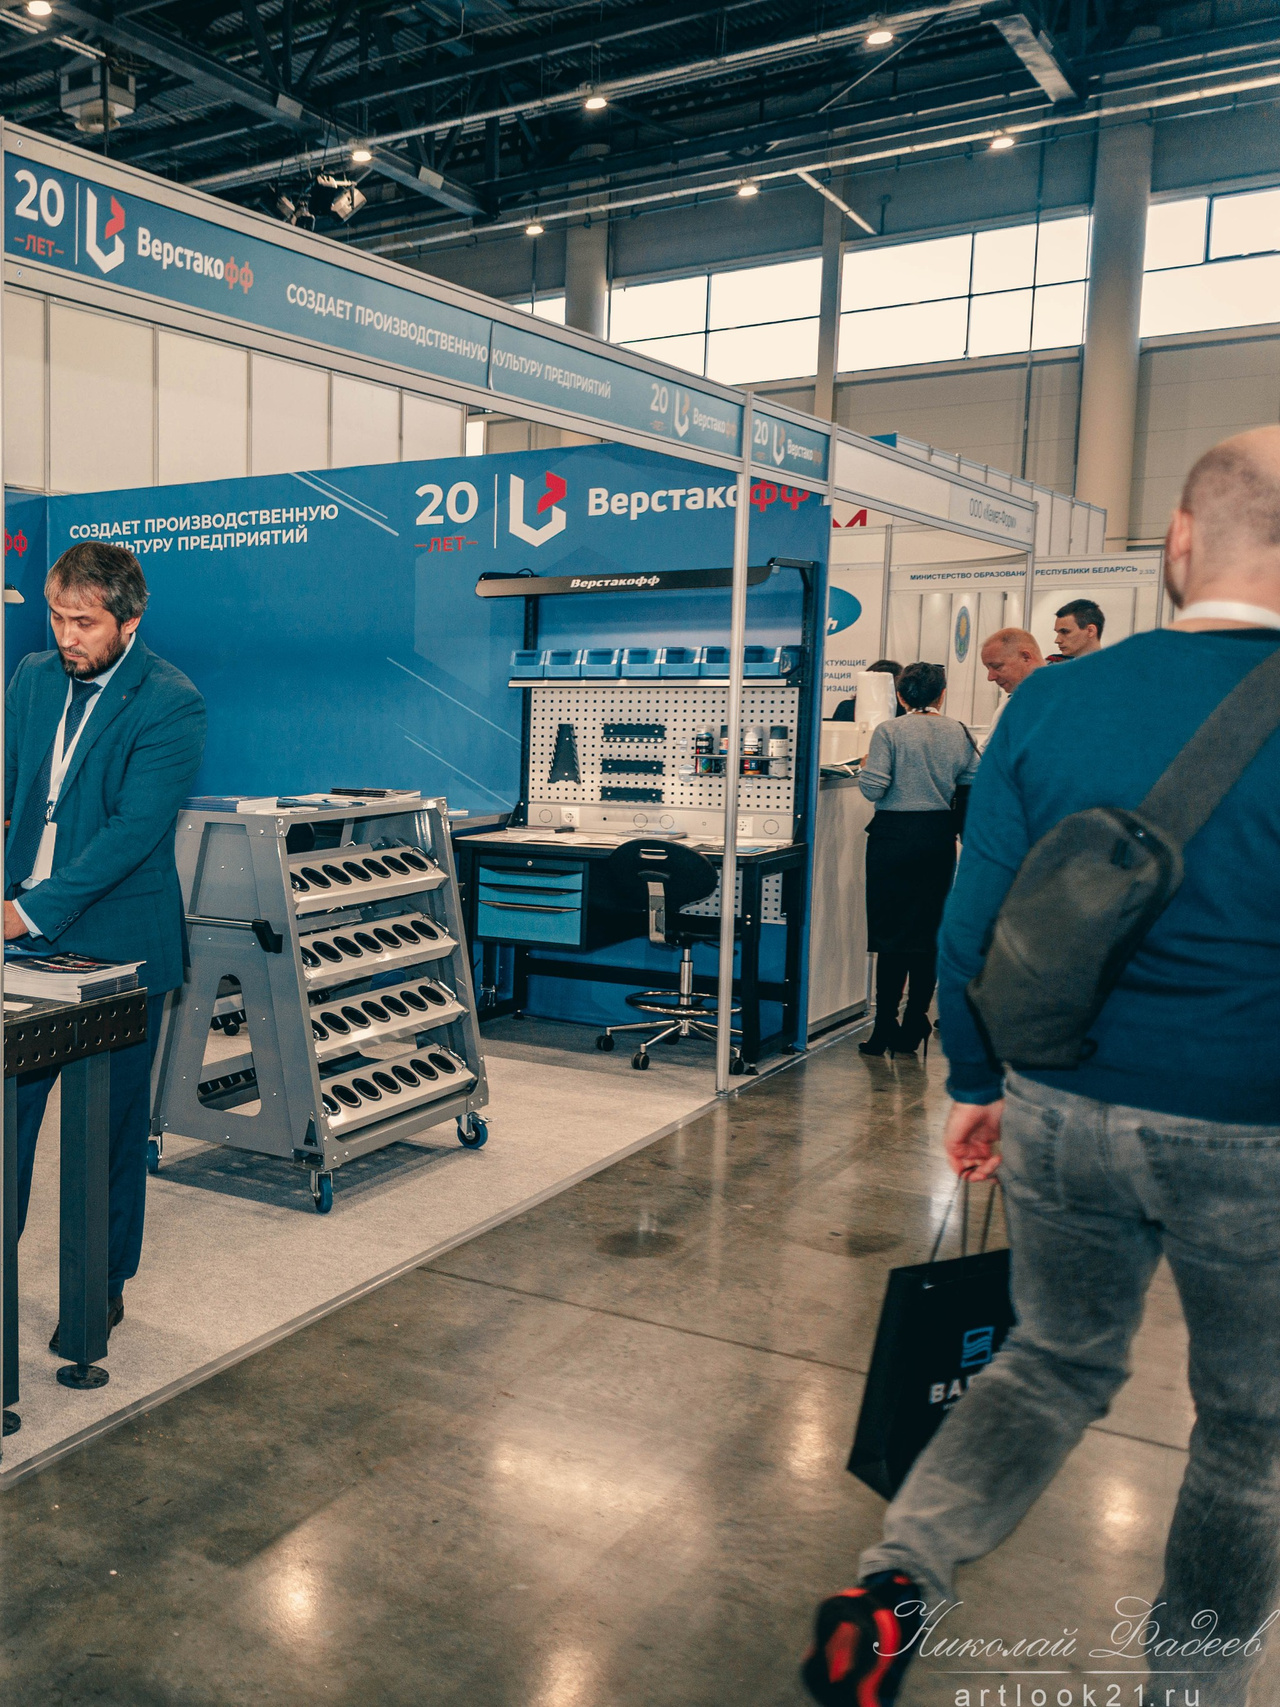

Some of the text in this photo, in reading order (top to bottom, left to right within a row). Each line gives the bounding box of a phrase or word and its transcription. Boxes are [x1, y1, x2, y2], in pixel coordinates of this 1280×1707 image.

[14, 169, 65, 227] 20
[136, 226, 254, 294] Верстакофф
[286, 283, 612, 399] СОЗДАЕТ ПРОИЗВОДСТВЕННУЮ КУЛЬТУРУ ПРЕДПРИЯТИЙ
[650, 382, 669, 414] 20
[754, 418, 769, 446] 20
[415, 481, 479, 526] 20
[69, 503, 339, 539] СОЗДАЕТ ПРОИЗВОДСТВЕННУЮ
[177, 524, 308, 551] ПРЕДПРИЯТИЙ
[570, 575, 660, 590] Верстакофф
[910, 565, 1138, 581] МИНИСТЕРСТВО ОБРАЗОВАНИ РЕСПУБЛИКИ БЕЛАРУСЬ
